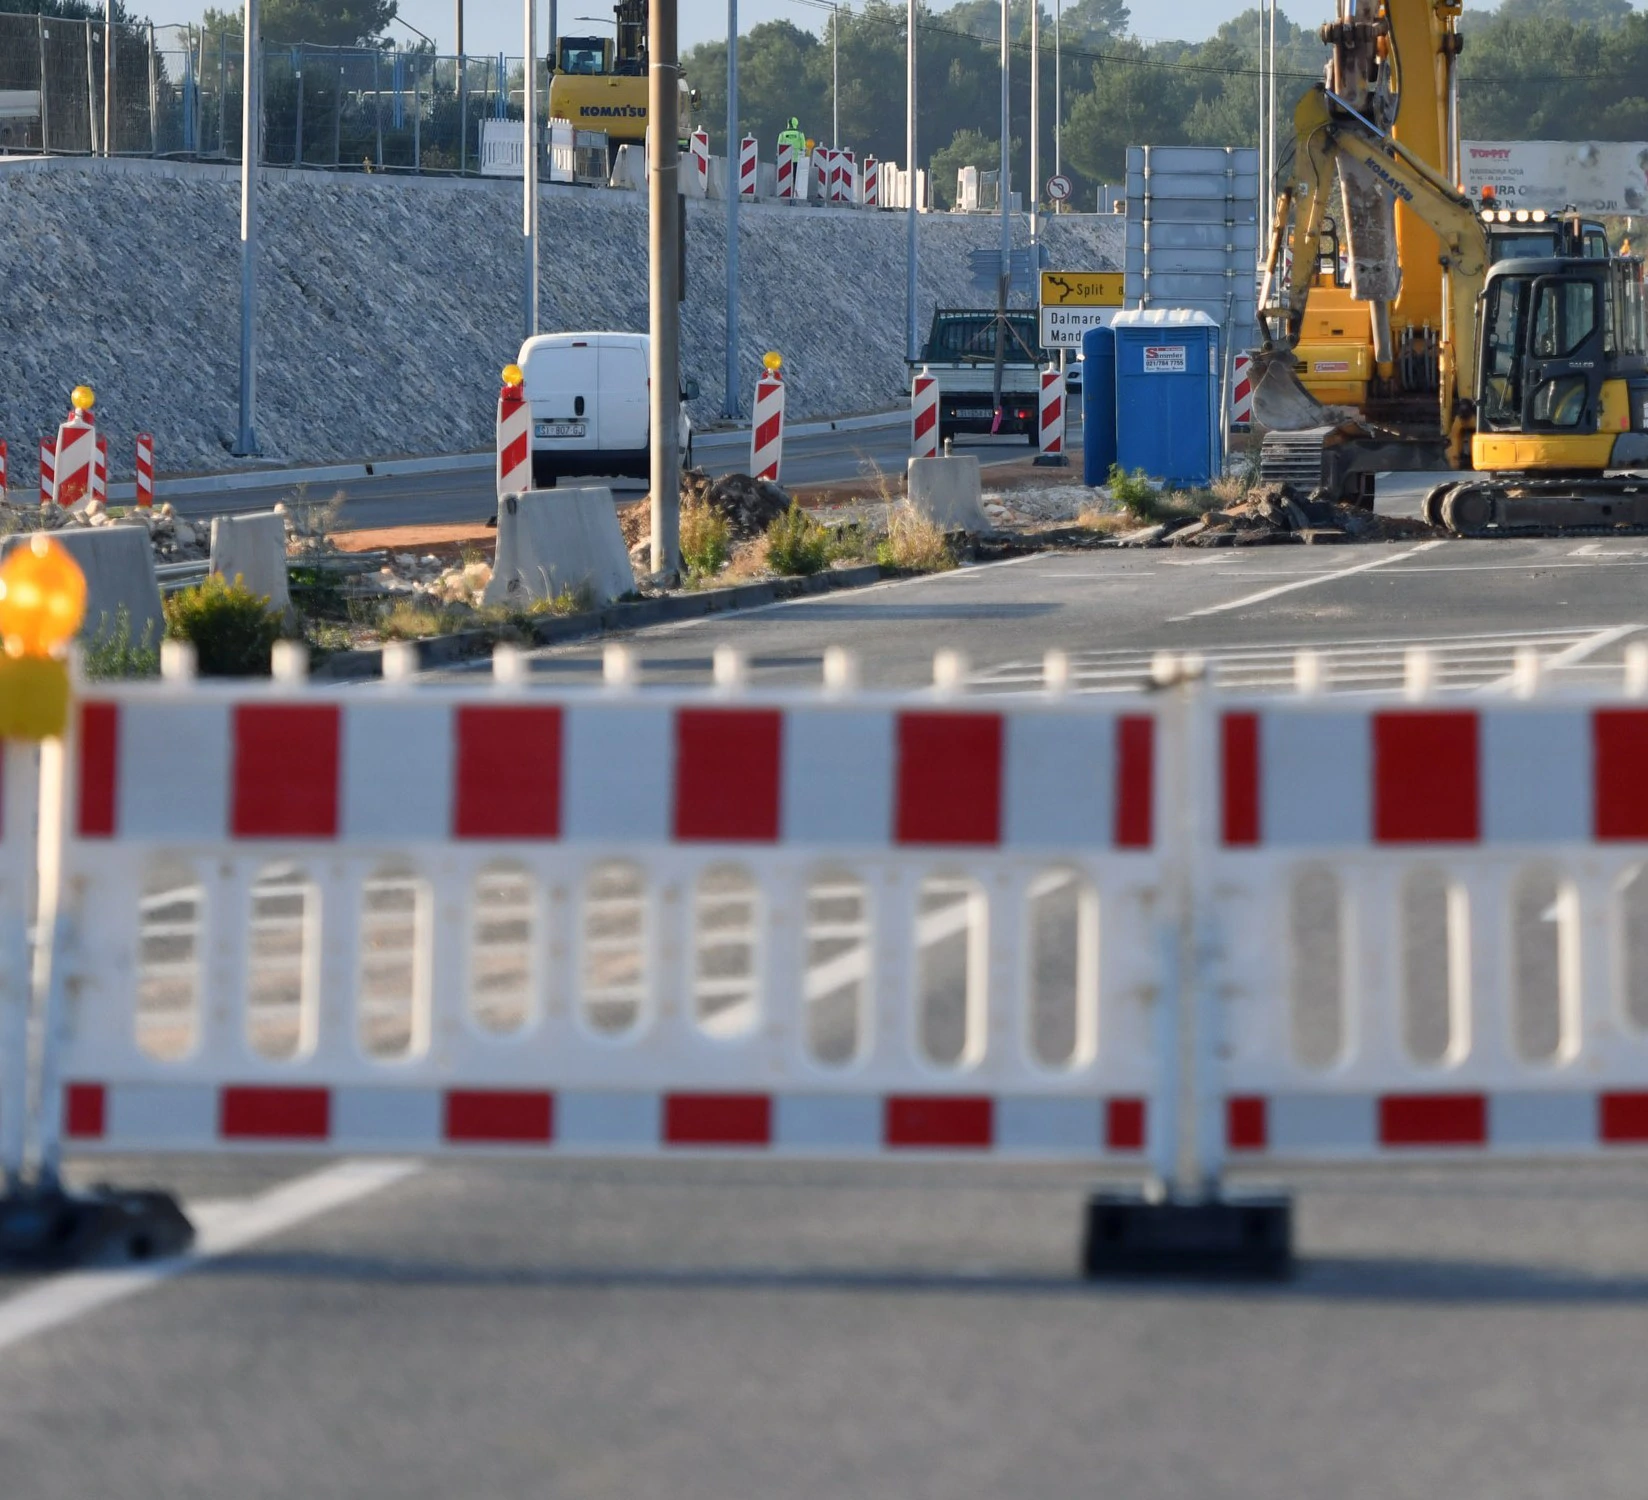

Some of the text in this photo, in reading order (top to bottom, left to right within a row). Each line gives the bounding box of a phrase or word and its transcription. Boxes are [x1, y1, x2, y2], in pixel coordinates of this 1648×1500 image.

[580, 104, 647, 117] KOMATSU
[1365, 157, 1413, 201] KOMATSU
[1076, 283, 1104, 298] Split
[1051, 312, 1101, 325] Dalmare
[1051, 330, 1081, 342] Mand
